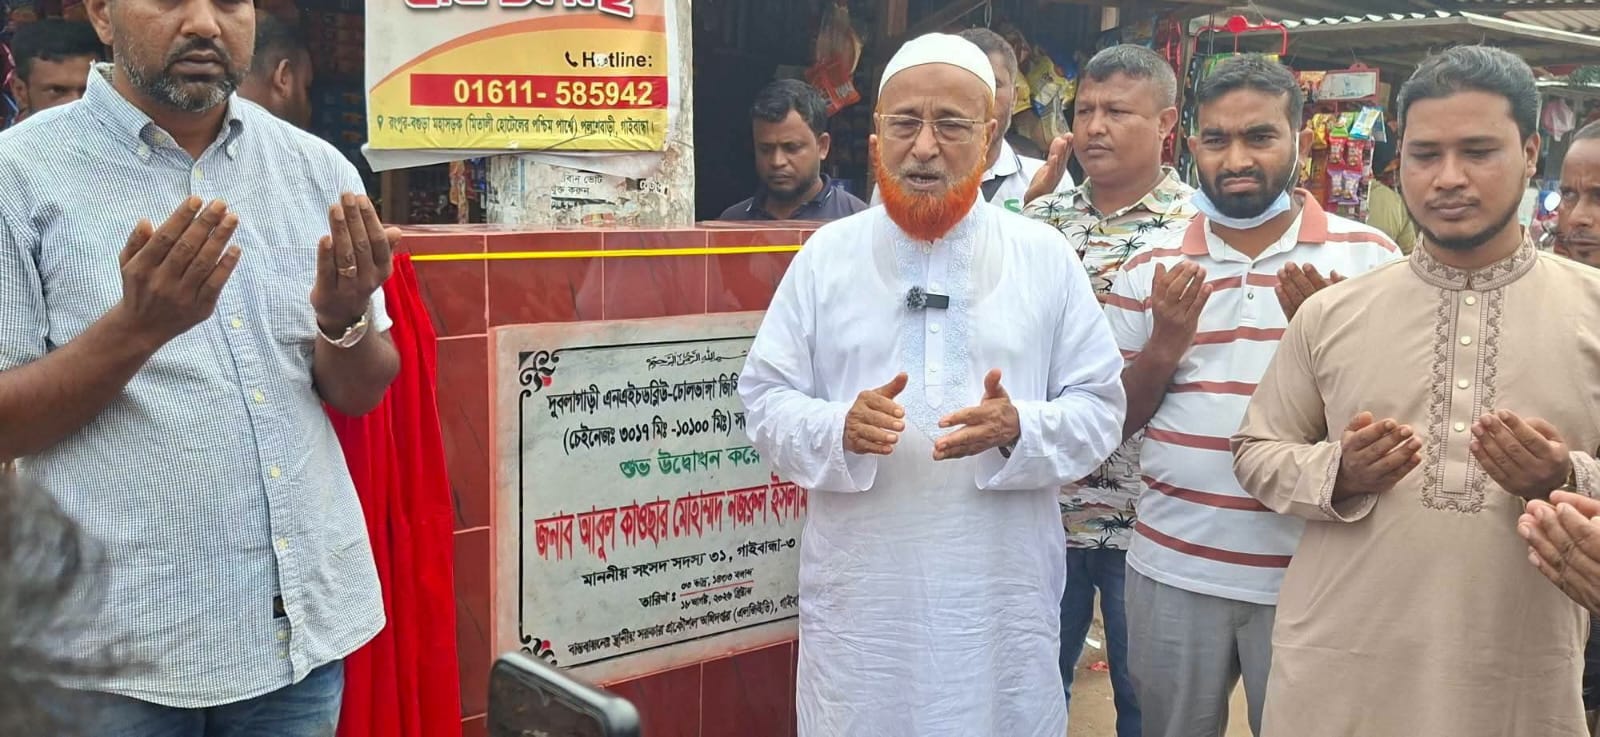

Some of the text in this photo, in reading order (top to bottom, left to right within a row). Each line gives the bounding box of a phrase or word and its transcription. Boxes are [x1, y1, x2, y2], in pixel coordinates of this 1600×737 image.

[582, 51, 652, 68] Htline:
[454, 79, 653, 105] 01611- 585942
[388, 116, 430, 133] রংপুর-বগুড়া
[432, 117, 463, 134] মহাসড়ক
[496, 115, 529, 132] হোটেলের
[532, 114, 553, 133] পশ্চিম
[619, 423, 649, 442] ৩০১৭
[671, 418, 709, 438] -১০১০০
[619, 458, 651, 478] শুভ
[657, 448, 723, 475] উদ্বোধন
[535, 471, 808, 563] জনাব আবুল কাওছার মোহাম্মদ নজরুল ইসলাম
[581, 565, 630, 587] মাননীয়
[632, 560, 669, 578] সংসদ
[670, 552, 706, 570] সদস্য
[736, 538, 796, 558] গাইবান্ধা-৩
[638, 591, 670, 608] তারিখ
[612, 628, 635, 648] স্থানীয়
[637, 624, 665, 640] সরকার
[666, 616, 698, 635] প্রকৌশল
[700, 610, 731, 625] অধিদপ্তর
